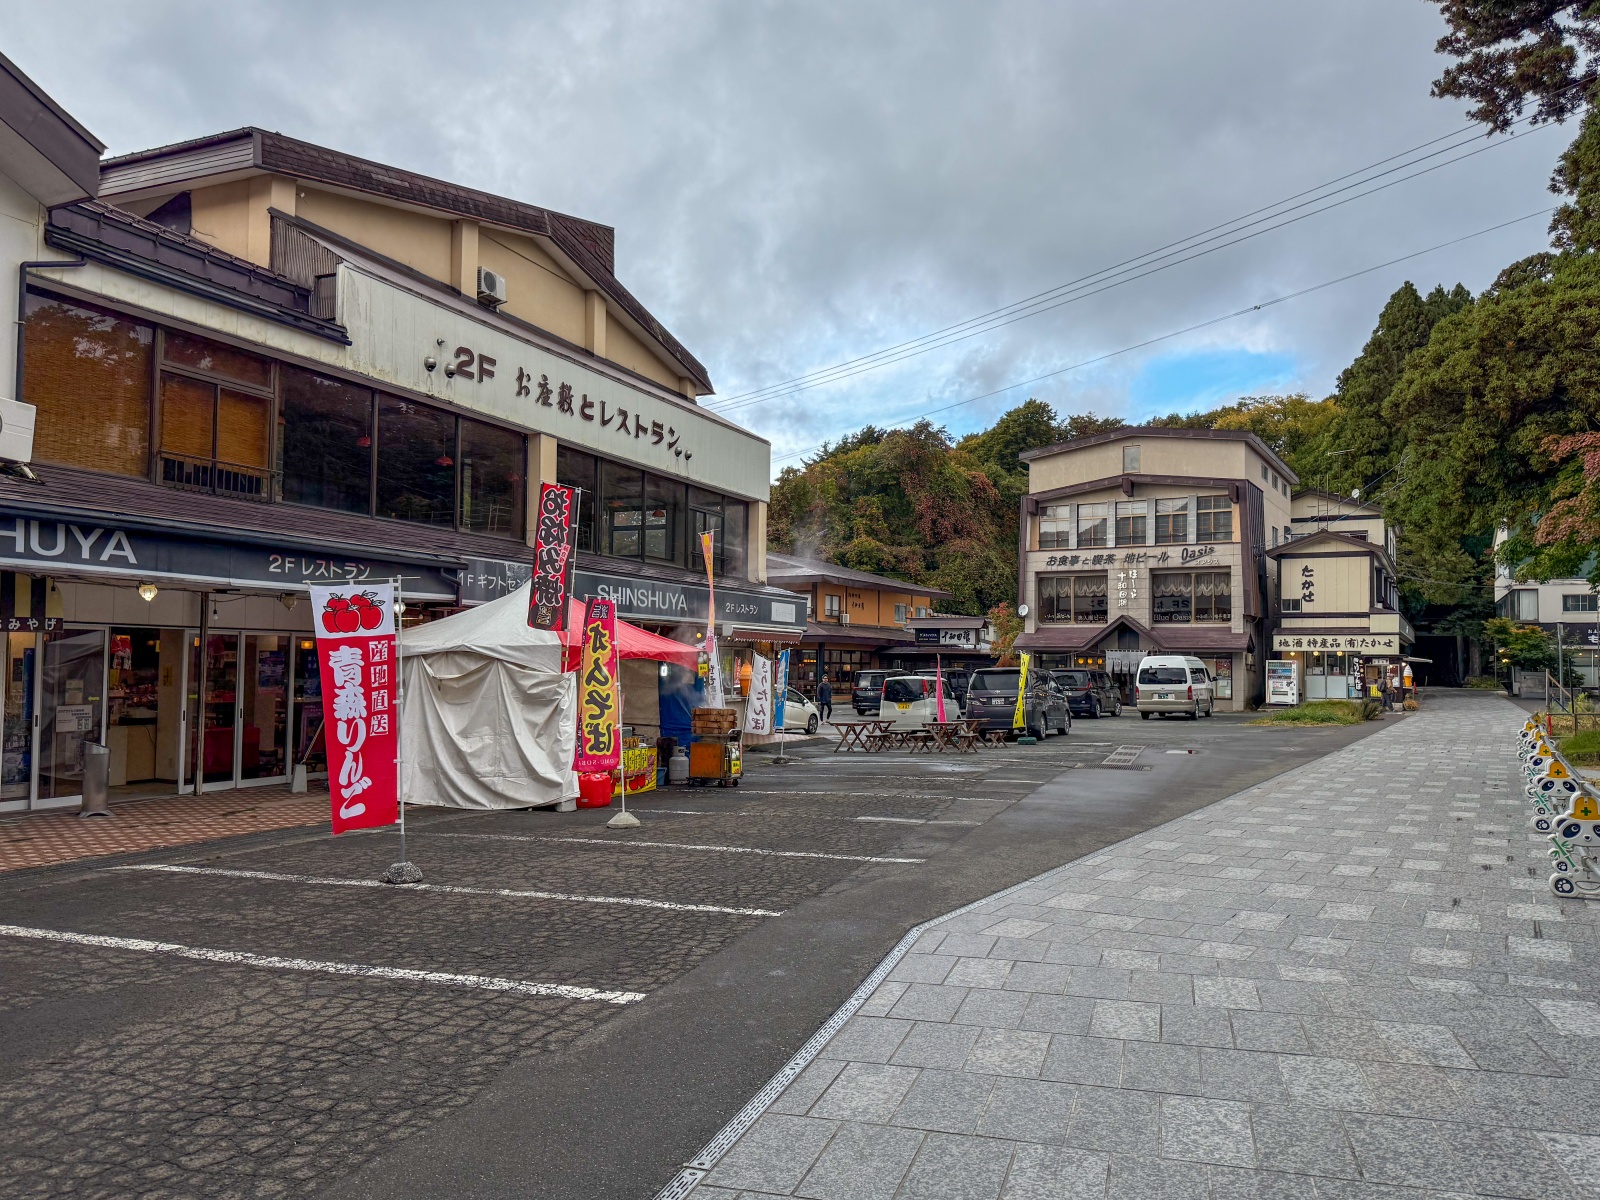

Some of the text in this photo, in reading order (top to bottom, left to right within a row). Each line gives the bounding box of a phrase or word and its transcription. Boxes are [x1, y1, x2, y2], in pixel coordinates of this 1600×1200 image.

[453, 346, 681, 450] 2F お座敷とレストラン
[268, 555, 370, 580] 2F レストラン
[1180, 546, 1216, 563] Oasis
[597, 584, 688, 611] SHINSHUYA
[1301, 565, 1315, 603] たかせ
[725, 602, 735, 613] 2F
[736, 603, 758, 615] レストラン
[1278, 638, 1303, 648] 地酒
[1307, 638, 1341, 648] 特産品
[369, 640, 389, 736] 産地直送
[328, 644, 374, 820] 青森りんご
